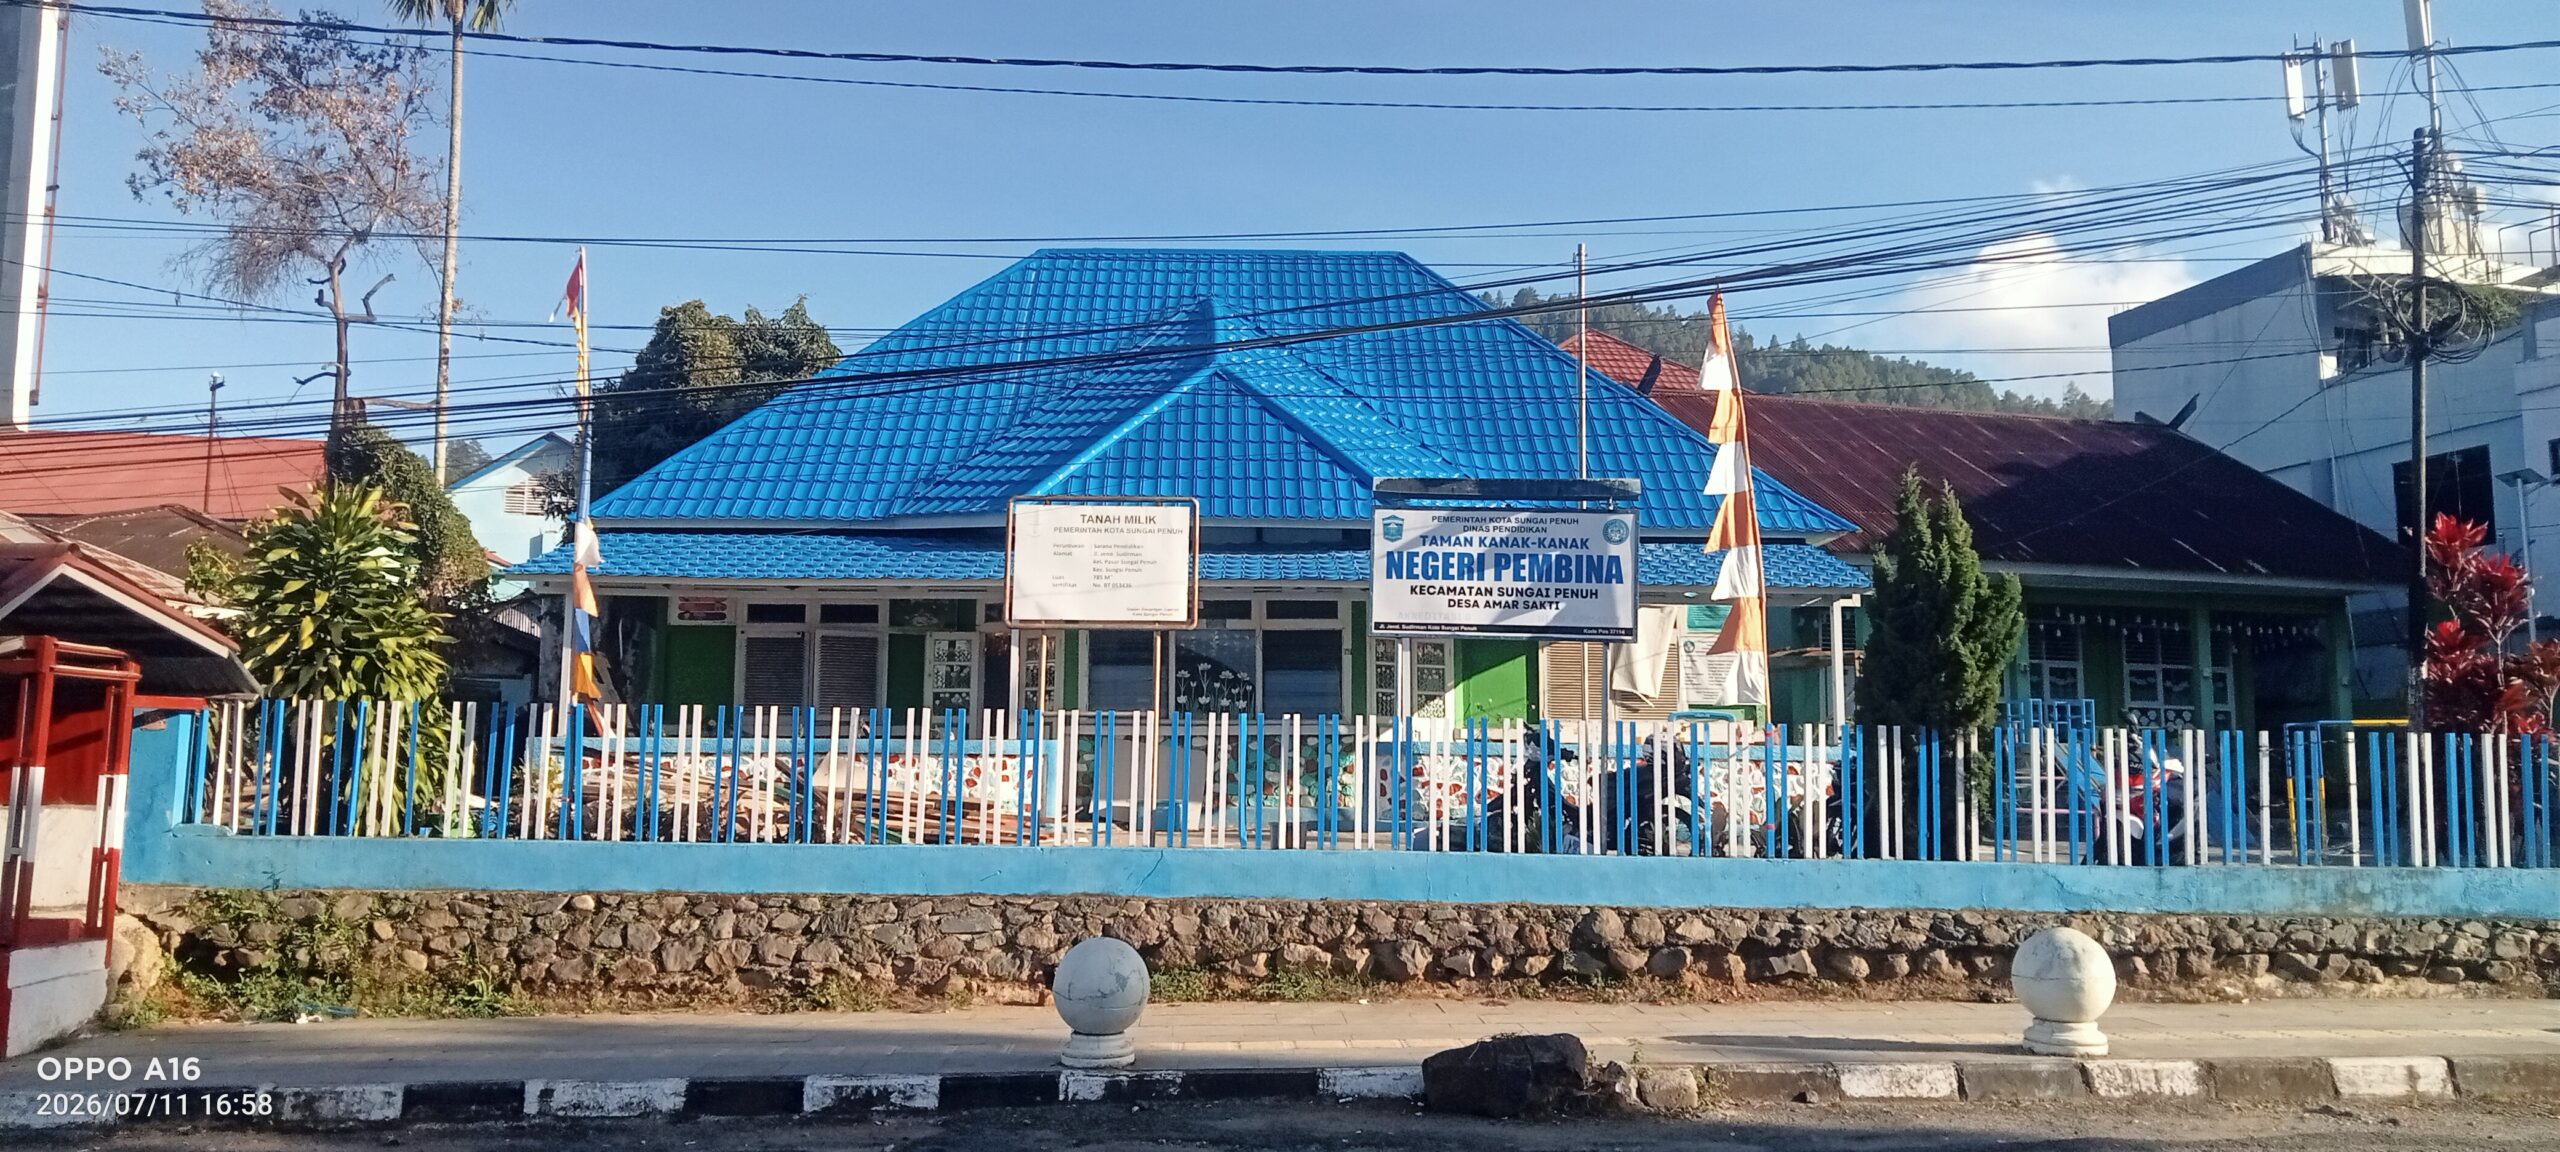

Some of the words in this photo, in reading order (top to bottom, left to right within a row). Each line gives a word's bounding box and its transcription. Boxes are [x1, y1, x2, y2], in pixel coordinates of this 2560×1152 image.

[1080, 514, 1120, 525] TANAH
[1124, 515, 1157, 525] MILIK
[1431, 515, 1487, 525] PEMERINTAH
[1488, 516, 1513, 525] KOTA
[1514, 516, 1548, 525] SUNGAI
[1548, 517, 1579, 525] PENUH
[1053, 526, 1102, 534] PEMERINTAH
[1462, 524, 1490, 533] DINAS
[1491, 525, 1548, 534] PENDIDIKAN
[1419, 535, 1474, 548] TAMAN
[1478, 536, 1590, 550] KANAK-KANAK
[1385, 550, 1485, 582] NEGERI
[1493, 552, 1625, 585] PEMBINA
[1409, 584, 1493, 598] KECAMATAN
[1496, 587, 1551, 598] SUNGAI
[1554, 588, 1599, 600] PENUH
[1447, 598, 1480, 609] DESA
[1482, 599, 1520, 610] AMAR
[1522, 600, 1560, 611] SAKTI
